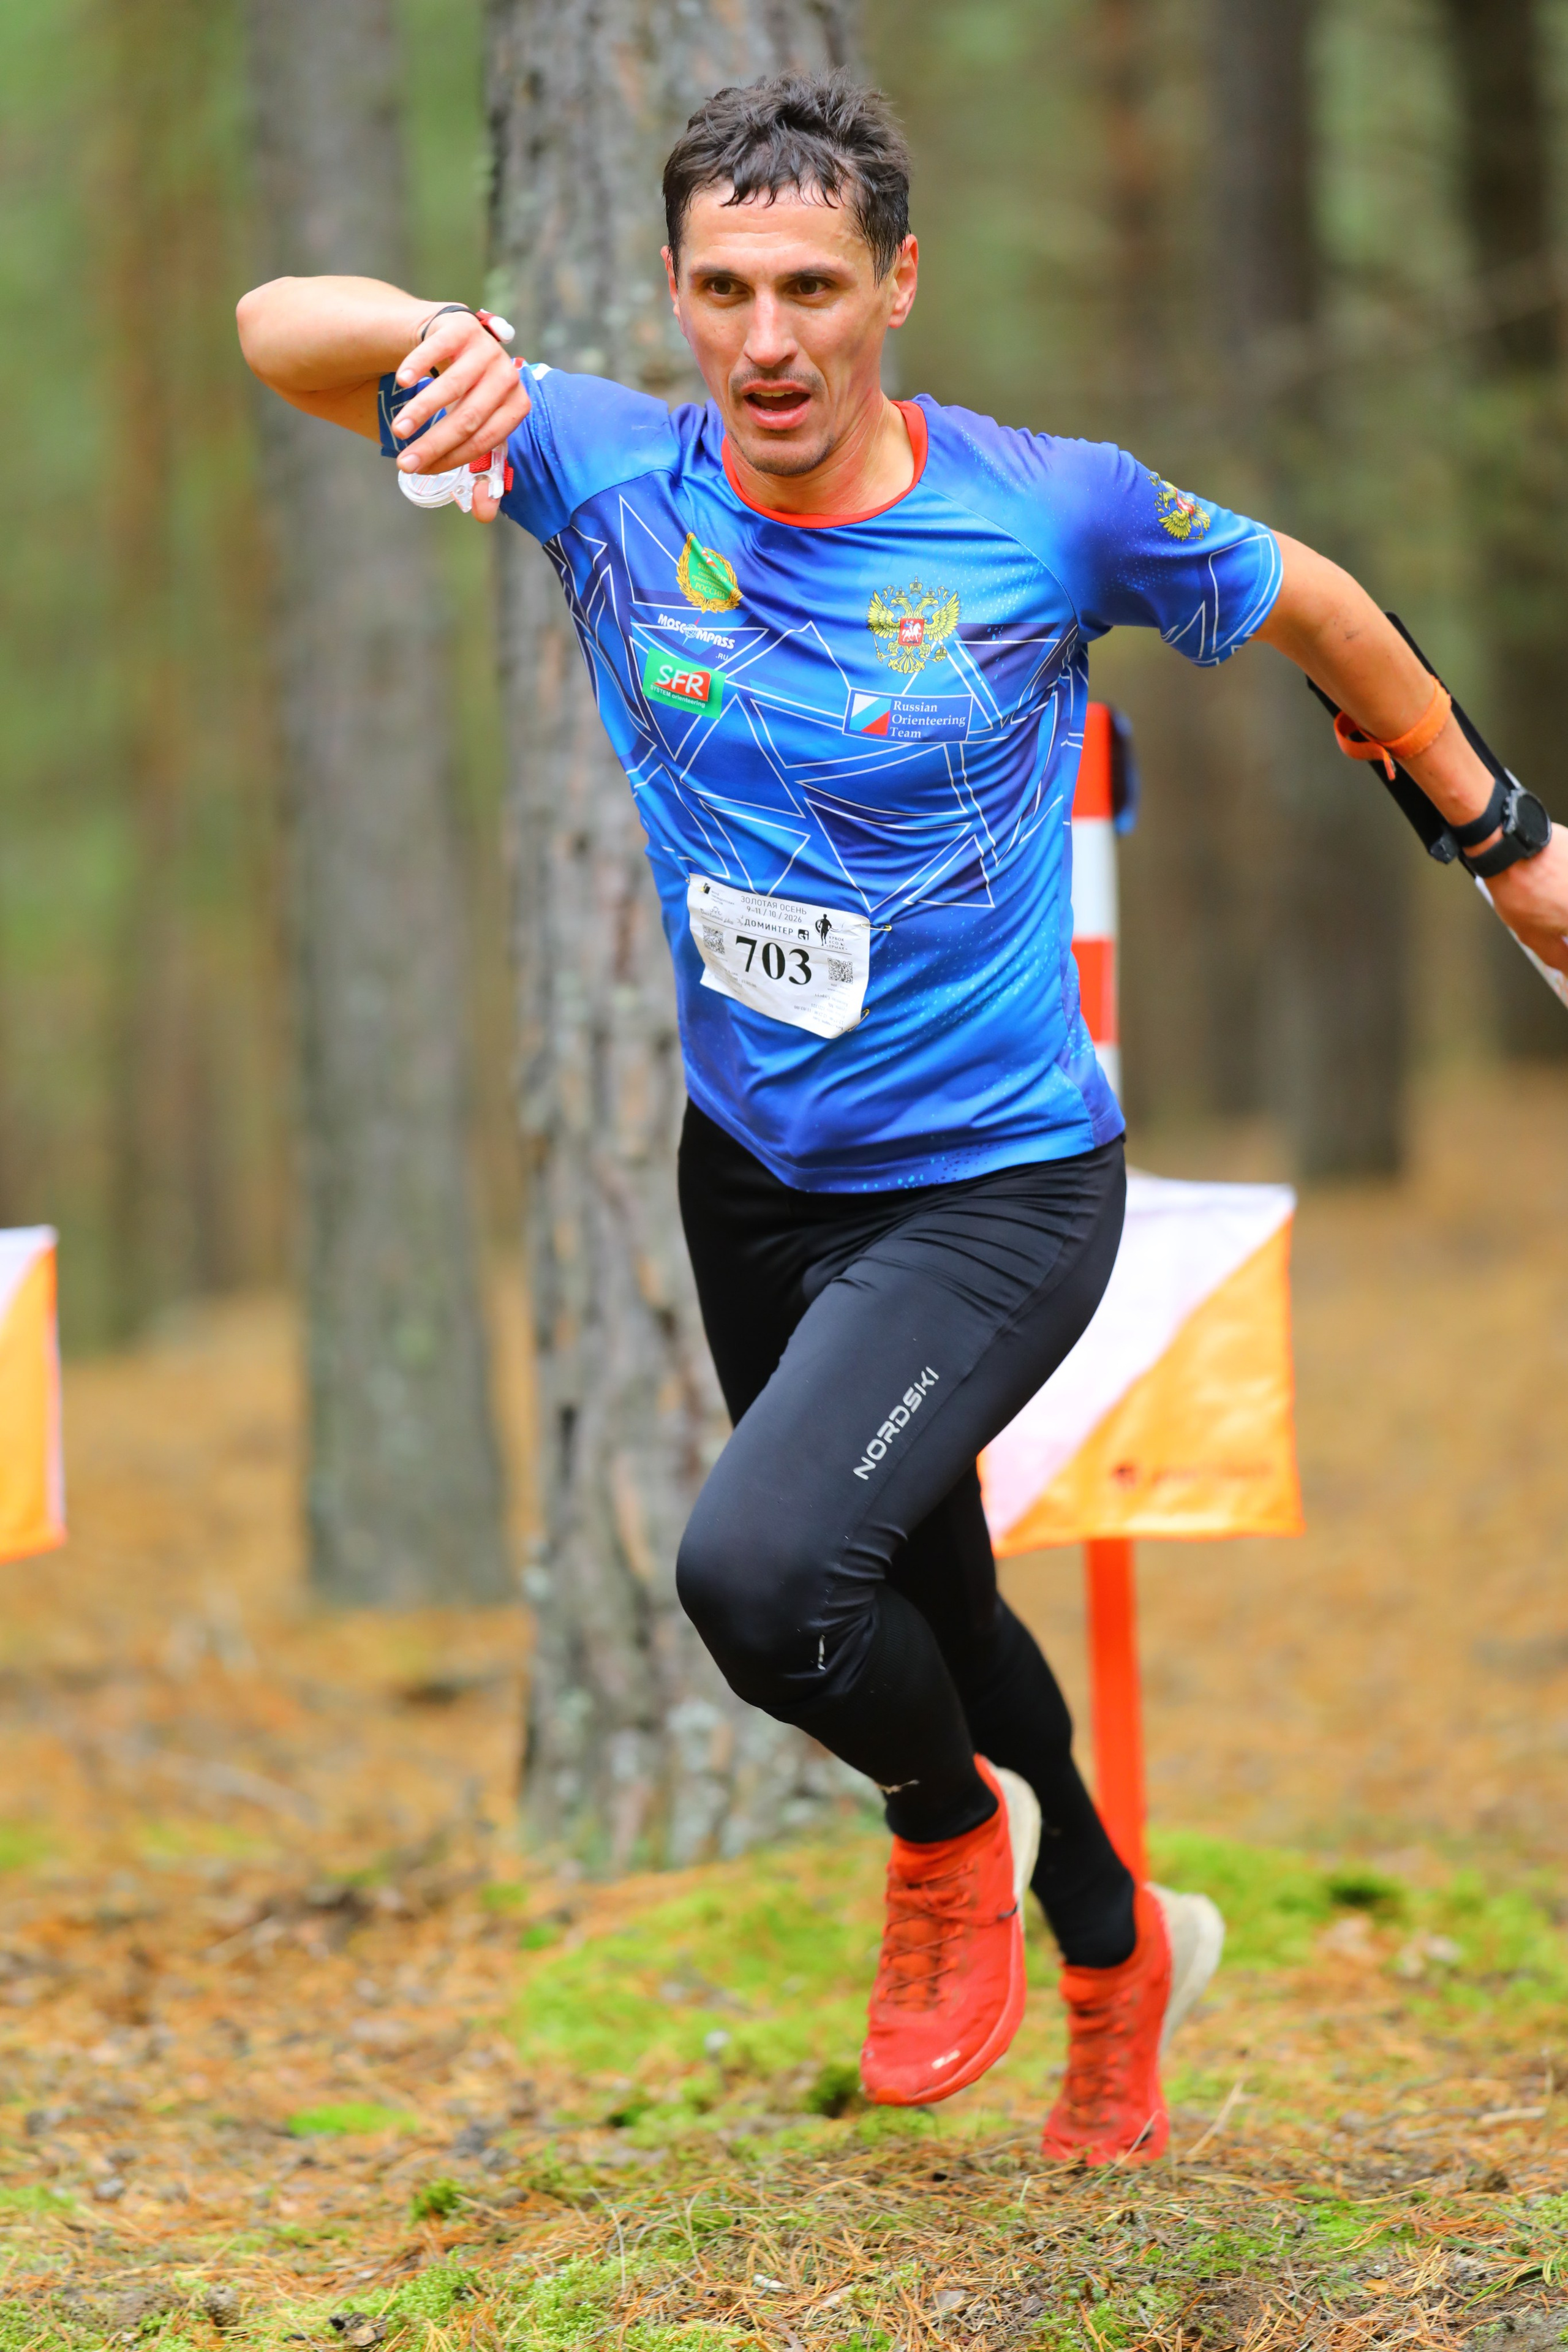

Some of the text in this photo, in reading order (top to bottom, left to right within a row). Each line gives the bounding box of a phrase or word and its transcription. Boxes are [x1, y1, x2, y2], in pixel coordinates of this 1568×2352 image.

[695, 582, 725, 598] РОССИИ
[715, 652, 729, 661] .RU
[656, 665, 704, 697] SFR
[649, 684, 706, 709] SYSTEM orienteering
[893, 700, 938, 712] Russian
[891, 714, 967, 728] Orienteering
[889, 726, 922, 739] Team
[740, 895, 778, 910] ЗОЛОТАЯ
[780, 903, 807, 915] ОСЕНЬ
[769, 910, 777, 918] 10
[784, 913, 802, 923] 2026
[744, 919, 794, 935] ДОМИНТЕР
[735, 935, 812, 986] 703
[853, 1366, 940, 1480] NORDSKI
